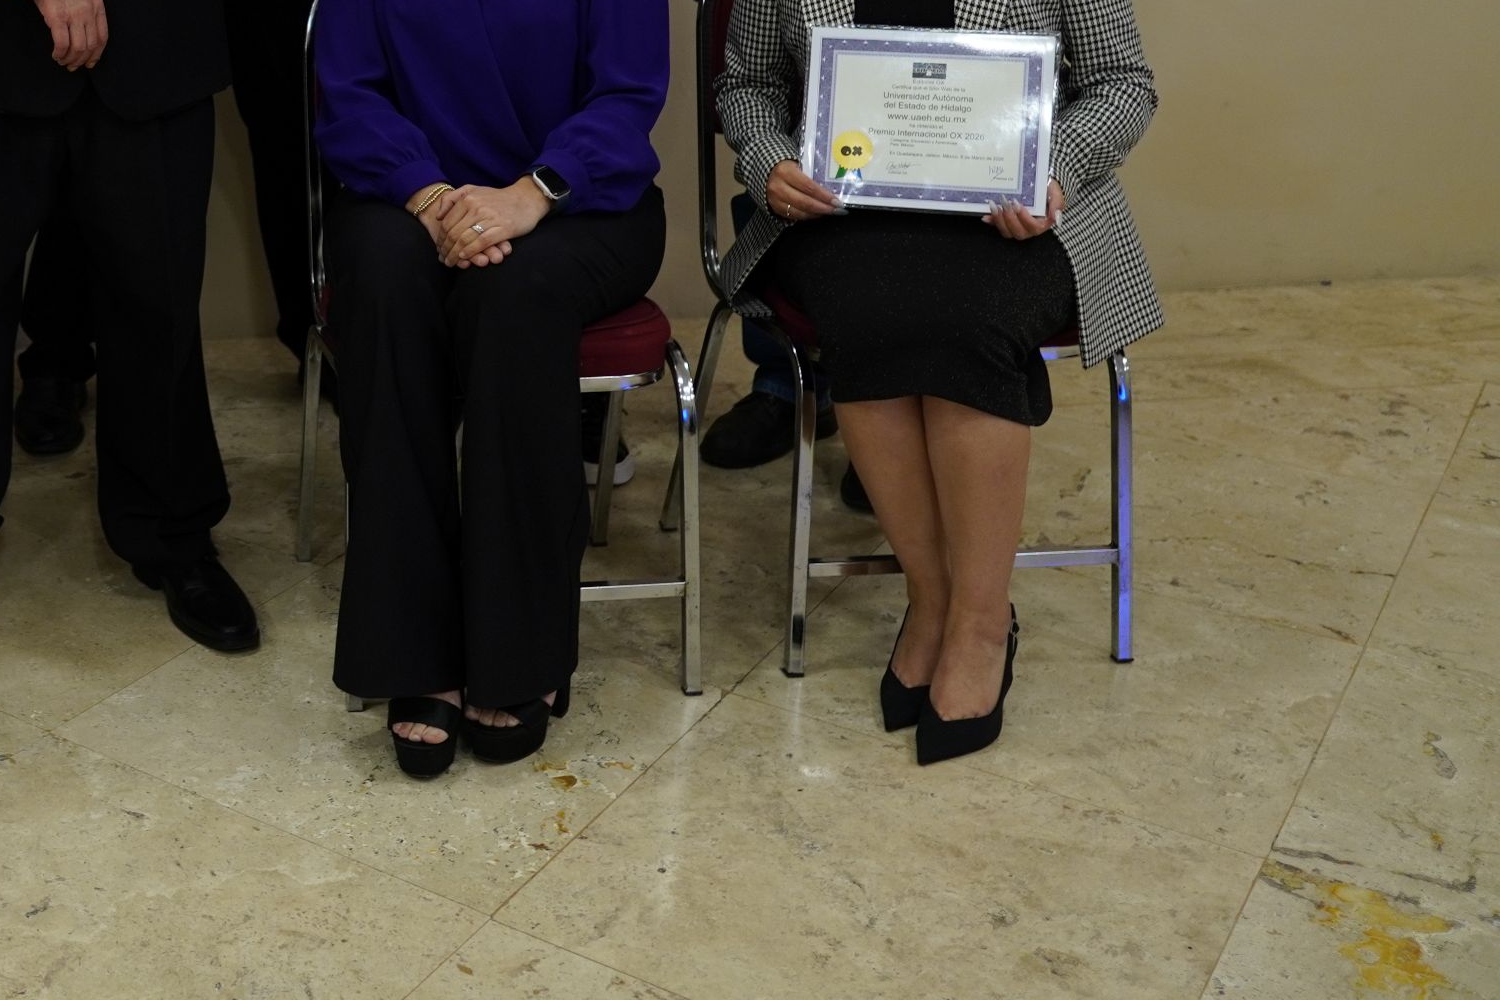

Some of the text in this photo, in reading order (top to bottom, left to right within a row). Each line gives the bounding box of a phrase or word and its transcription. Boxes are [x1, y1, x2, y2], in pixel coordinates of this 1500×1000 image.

[883, 92, 974, 103] Universidad Autónoma
[884, 101, 896, 109] del
[899, 102, 926, 110] Estado
[941, 104, 972, 112] Hidalgo
[869, 128, 895, 136] Premio
[898, 130, 947, 139] Internacional
